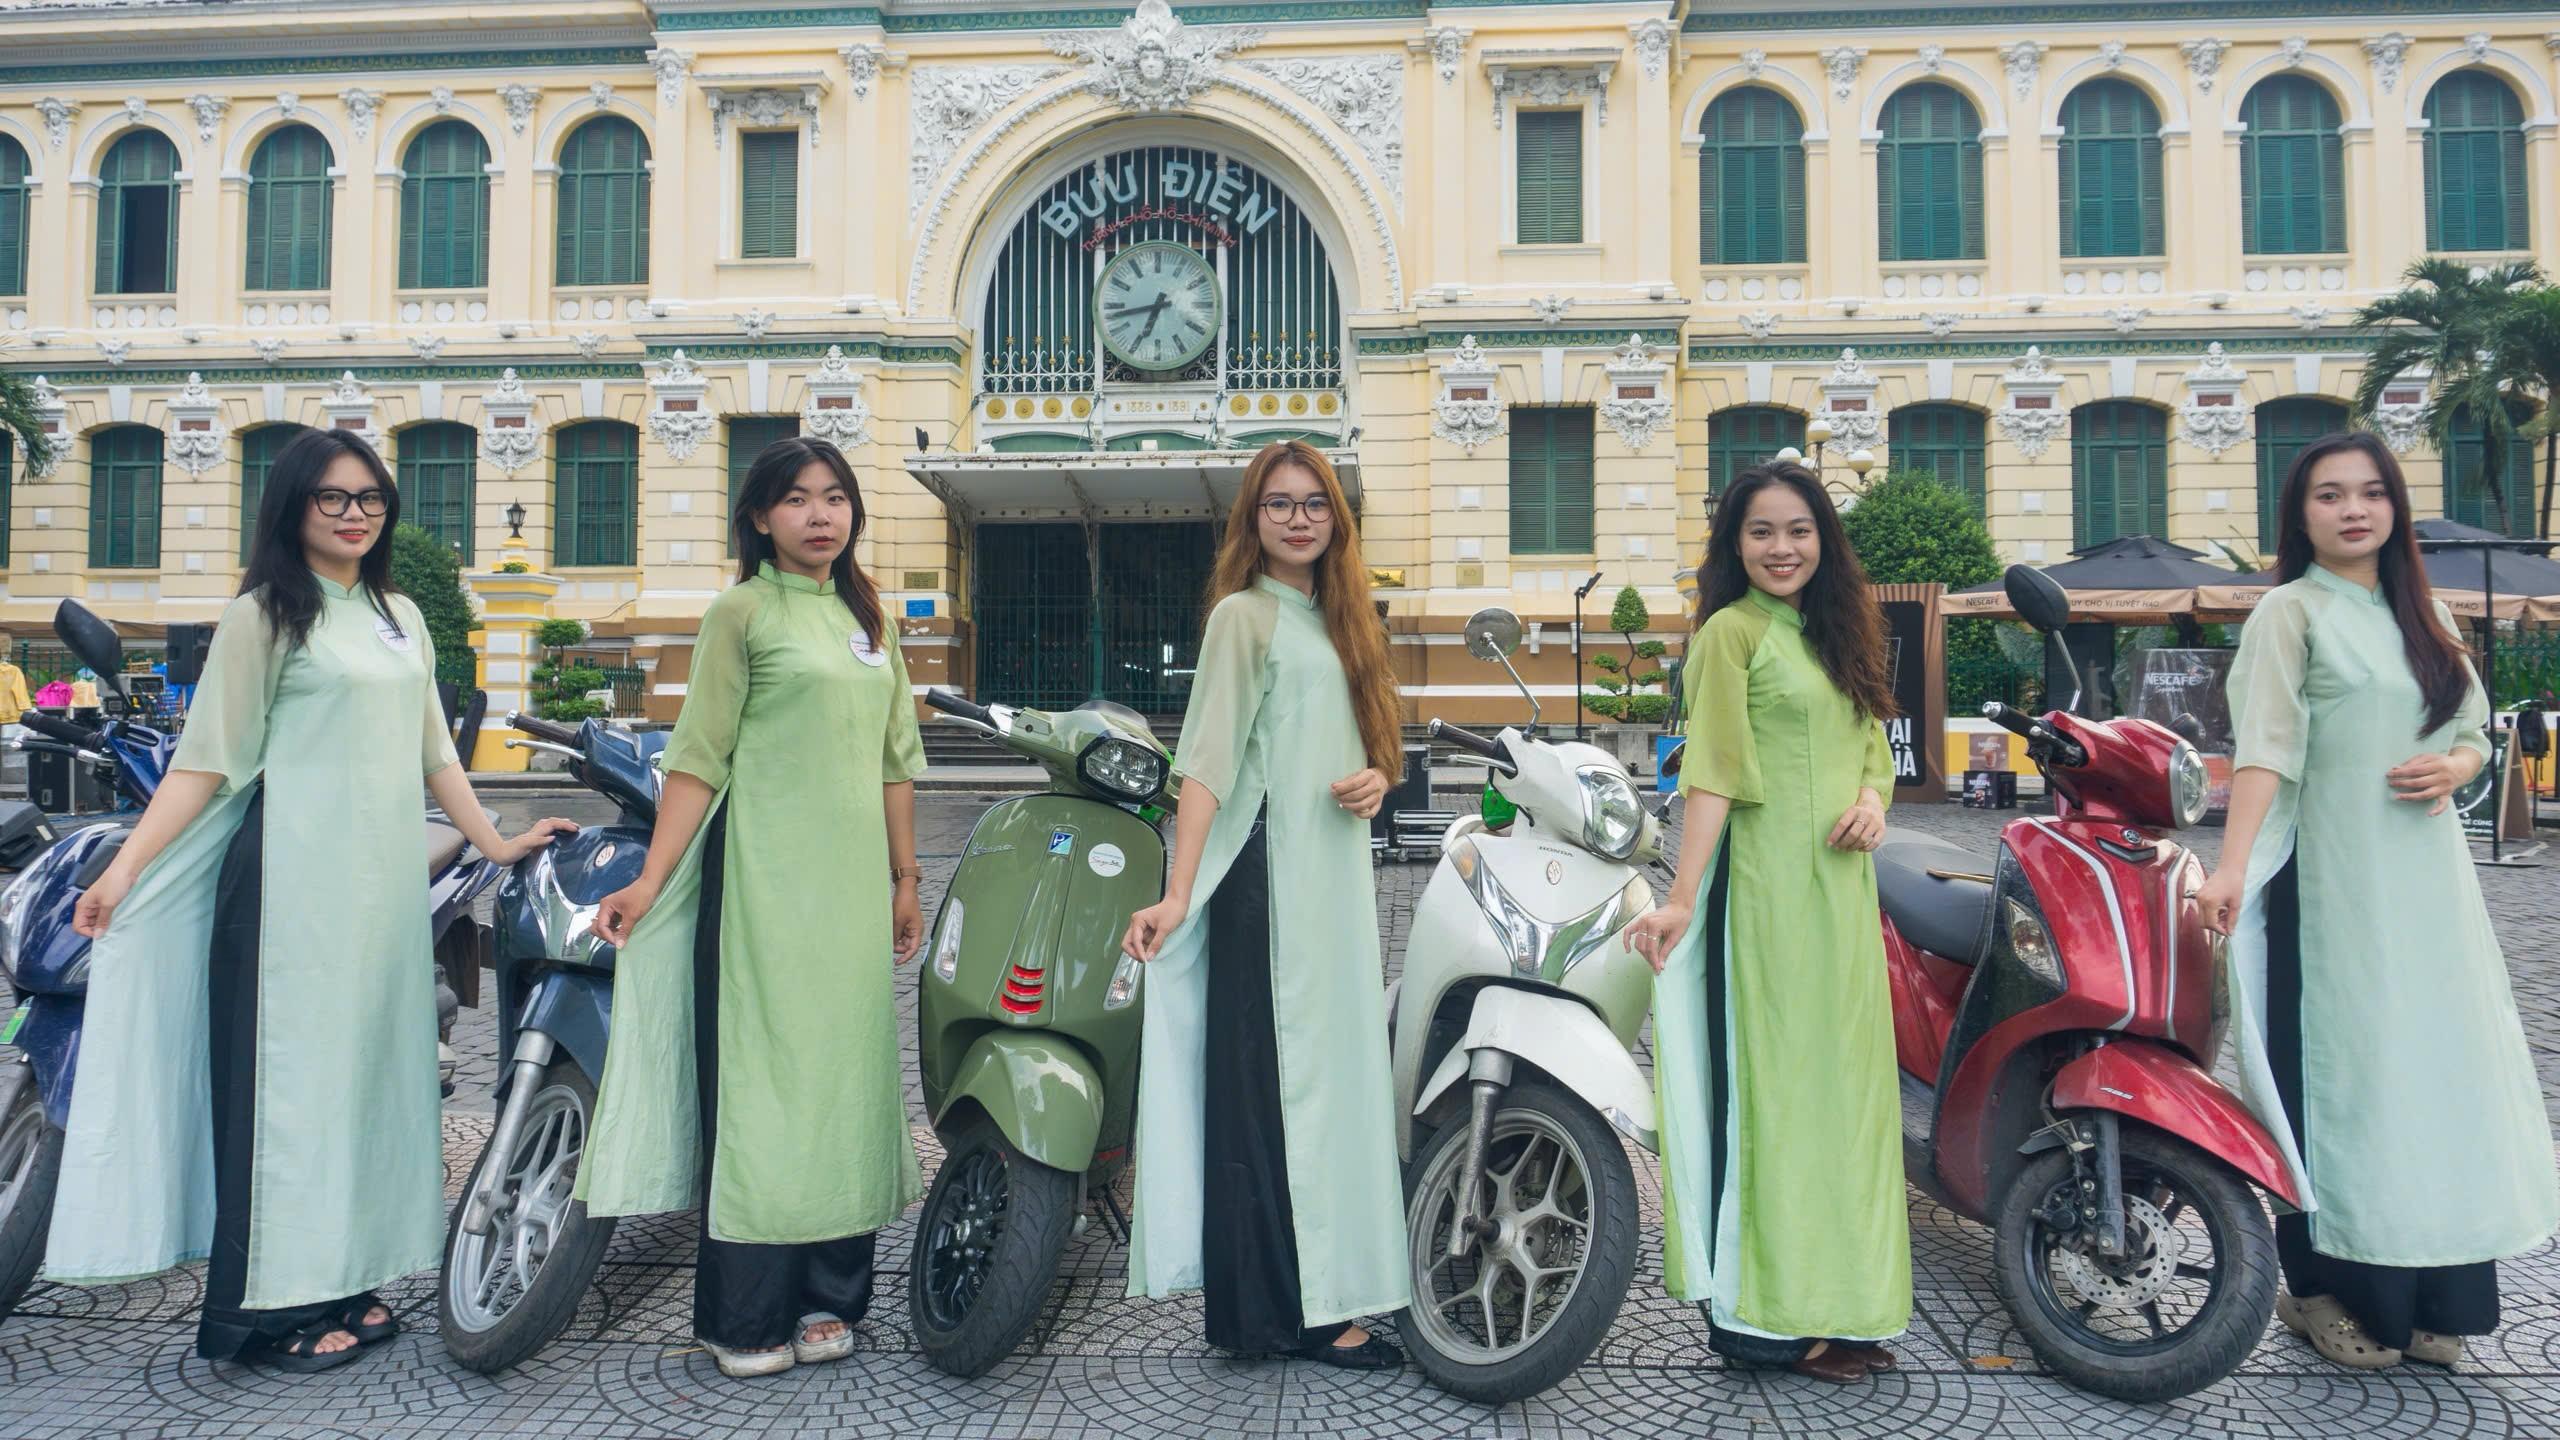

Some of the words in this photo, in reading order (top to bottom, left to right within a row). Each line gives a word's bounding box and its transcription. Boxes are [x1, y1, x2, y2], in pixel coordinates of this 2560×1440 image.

[1162, 161, 1278, 235] ĐIỆN
[1203, 222, 1237, 249] MINH
[2232, 591, 2264, 602] NESCA
